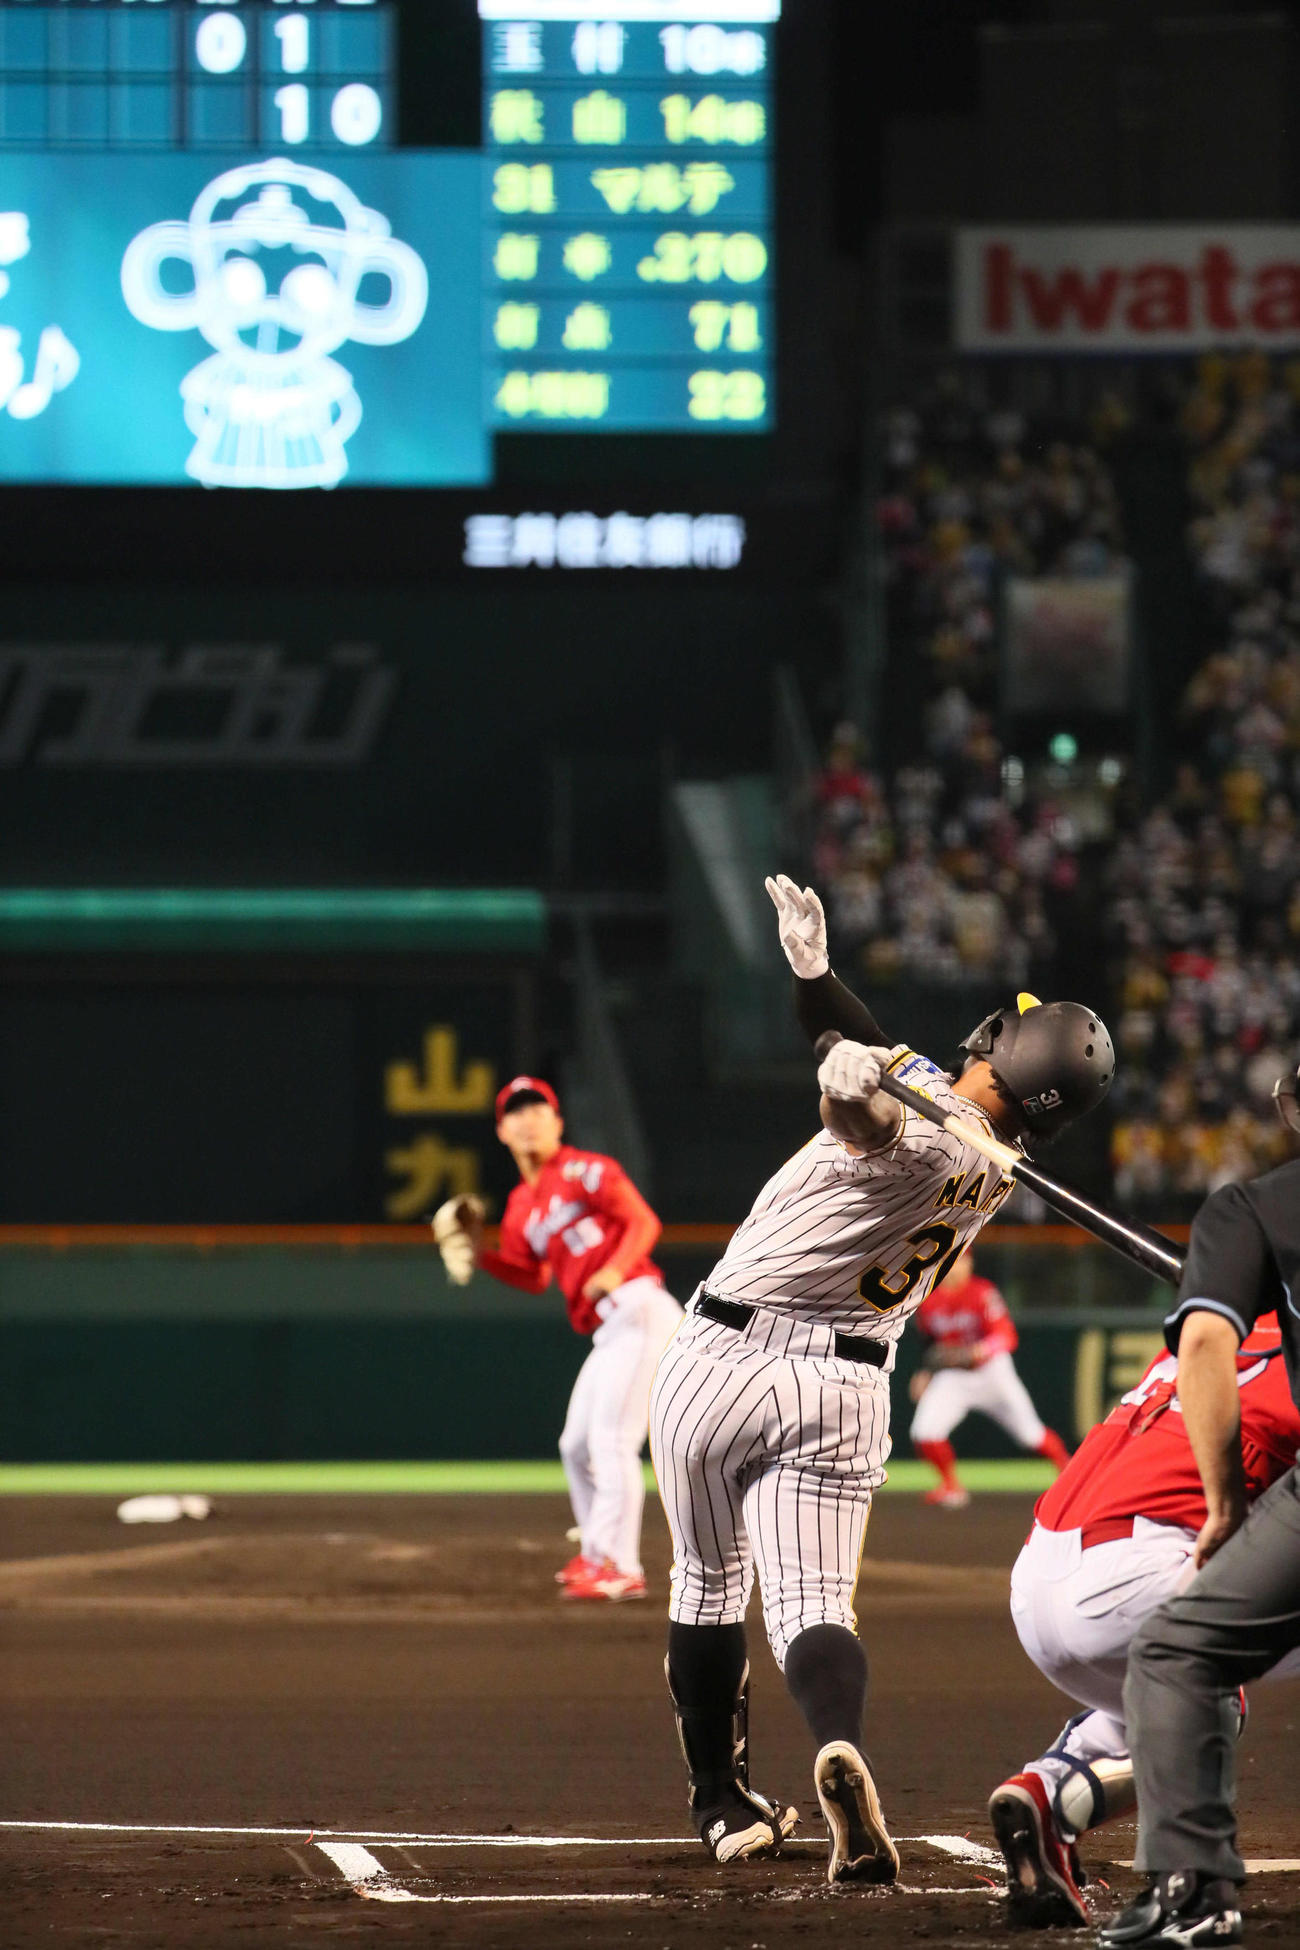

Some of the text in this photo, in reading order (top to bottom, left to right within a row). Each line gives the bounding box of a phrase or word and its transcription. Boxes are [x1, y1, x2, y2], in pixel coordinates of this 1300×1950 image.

[195, 11, 310, 74] 0 1
[273, 82, 382, 146] 1 0
[982, 240, 1300, 335] Iwata
[1040, 1088, 1063, 1110] 31
[932, 1170, 1017, 1214] MAR
